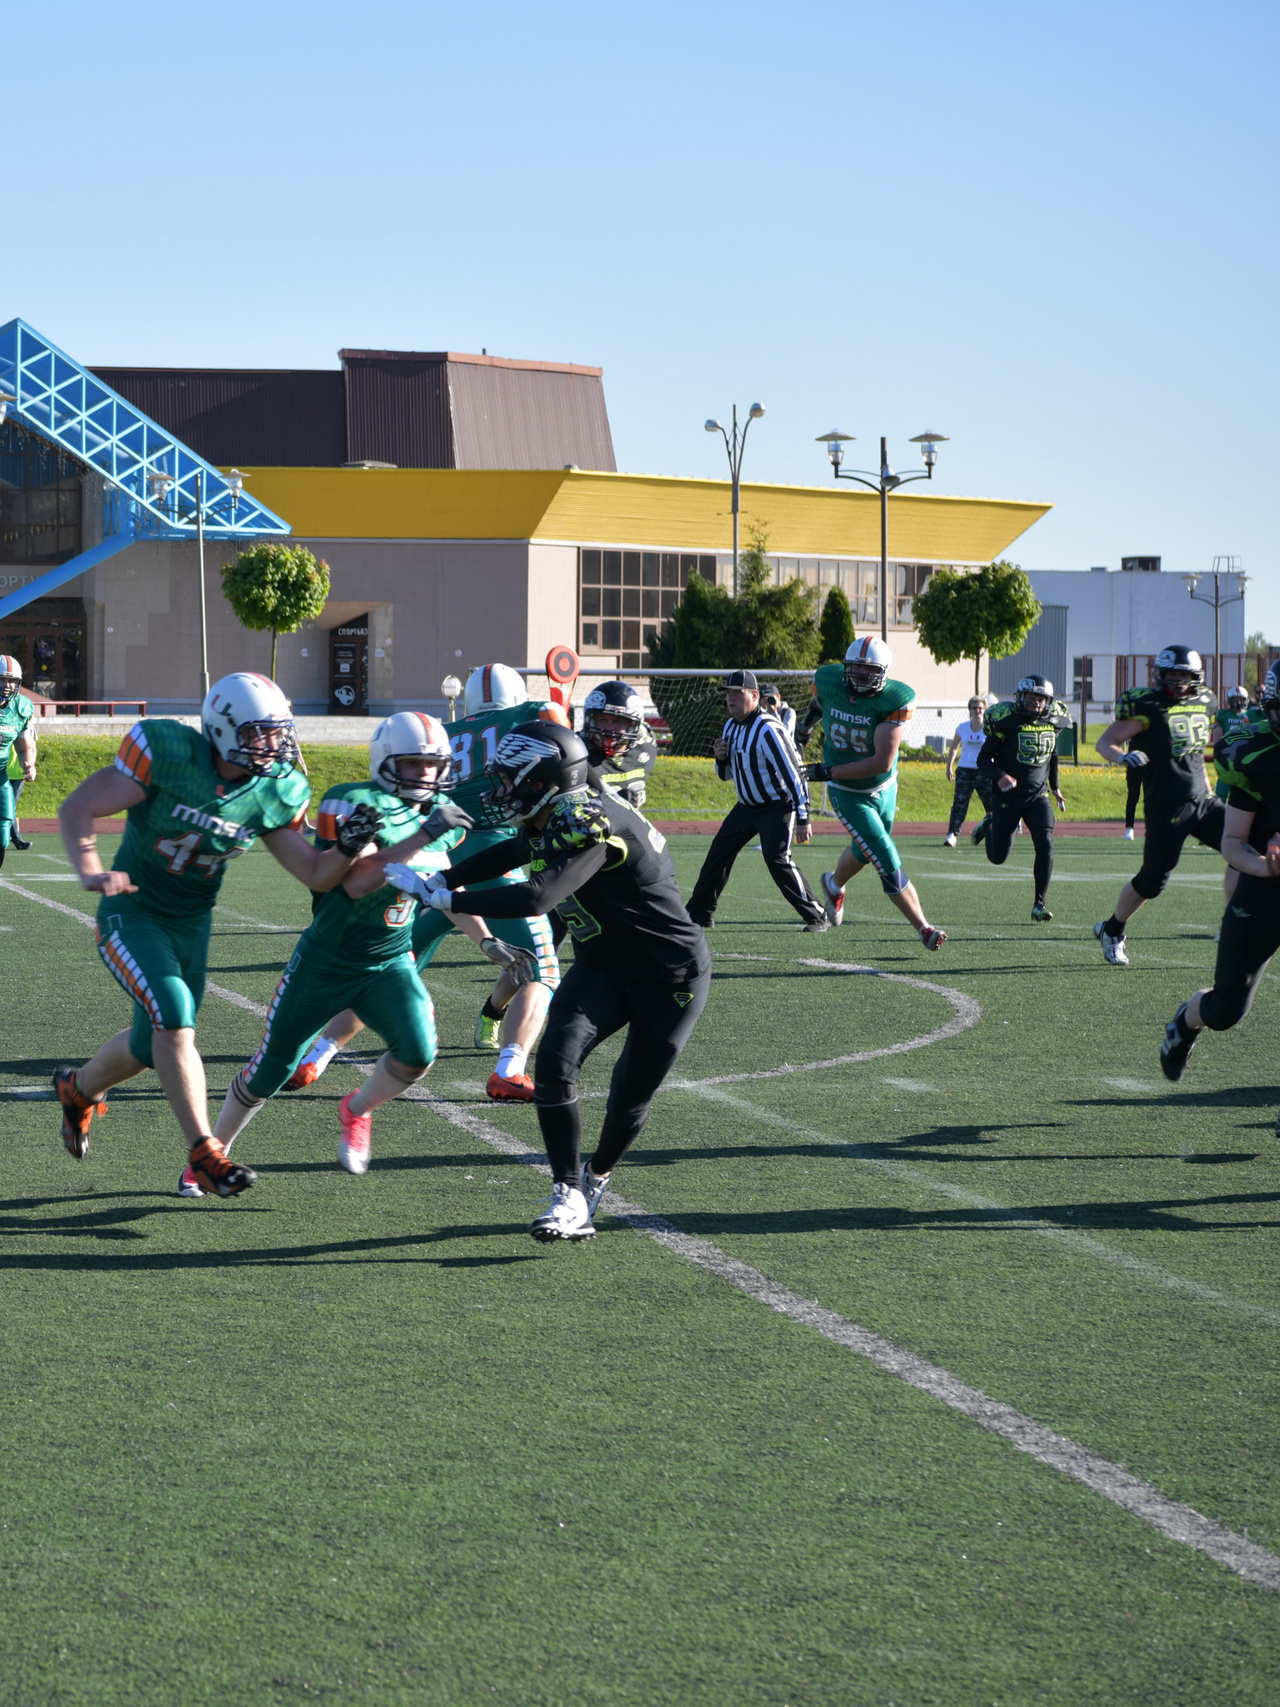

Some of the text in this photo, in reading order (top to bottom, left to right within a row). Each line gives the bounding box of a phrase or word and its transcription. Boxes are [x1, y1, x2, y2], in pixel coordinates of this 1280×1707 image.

[829, 722, 870, 755] 65
[1017, 731, 1056, 764] 50
[1168, 714, 1210, 757] 93
